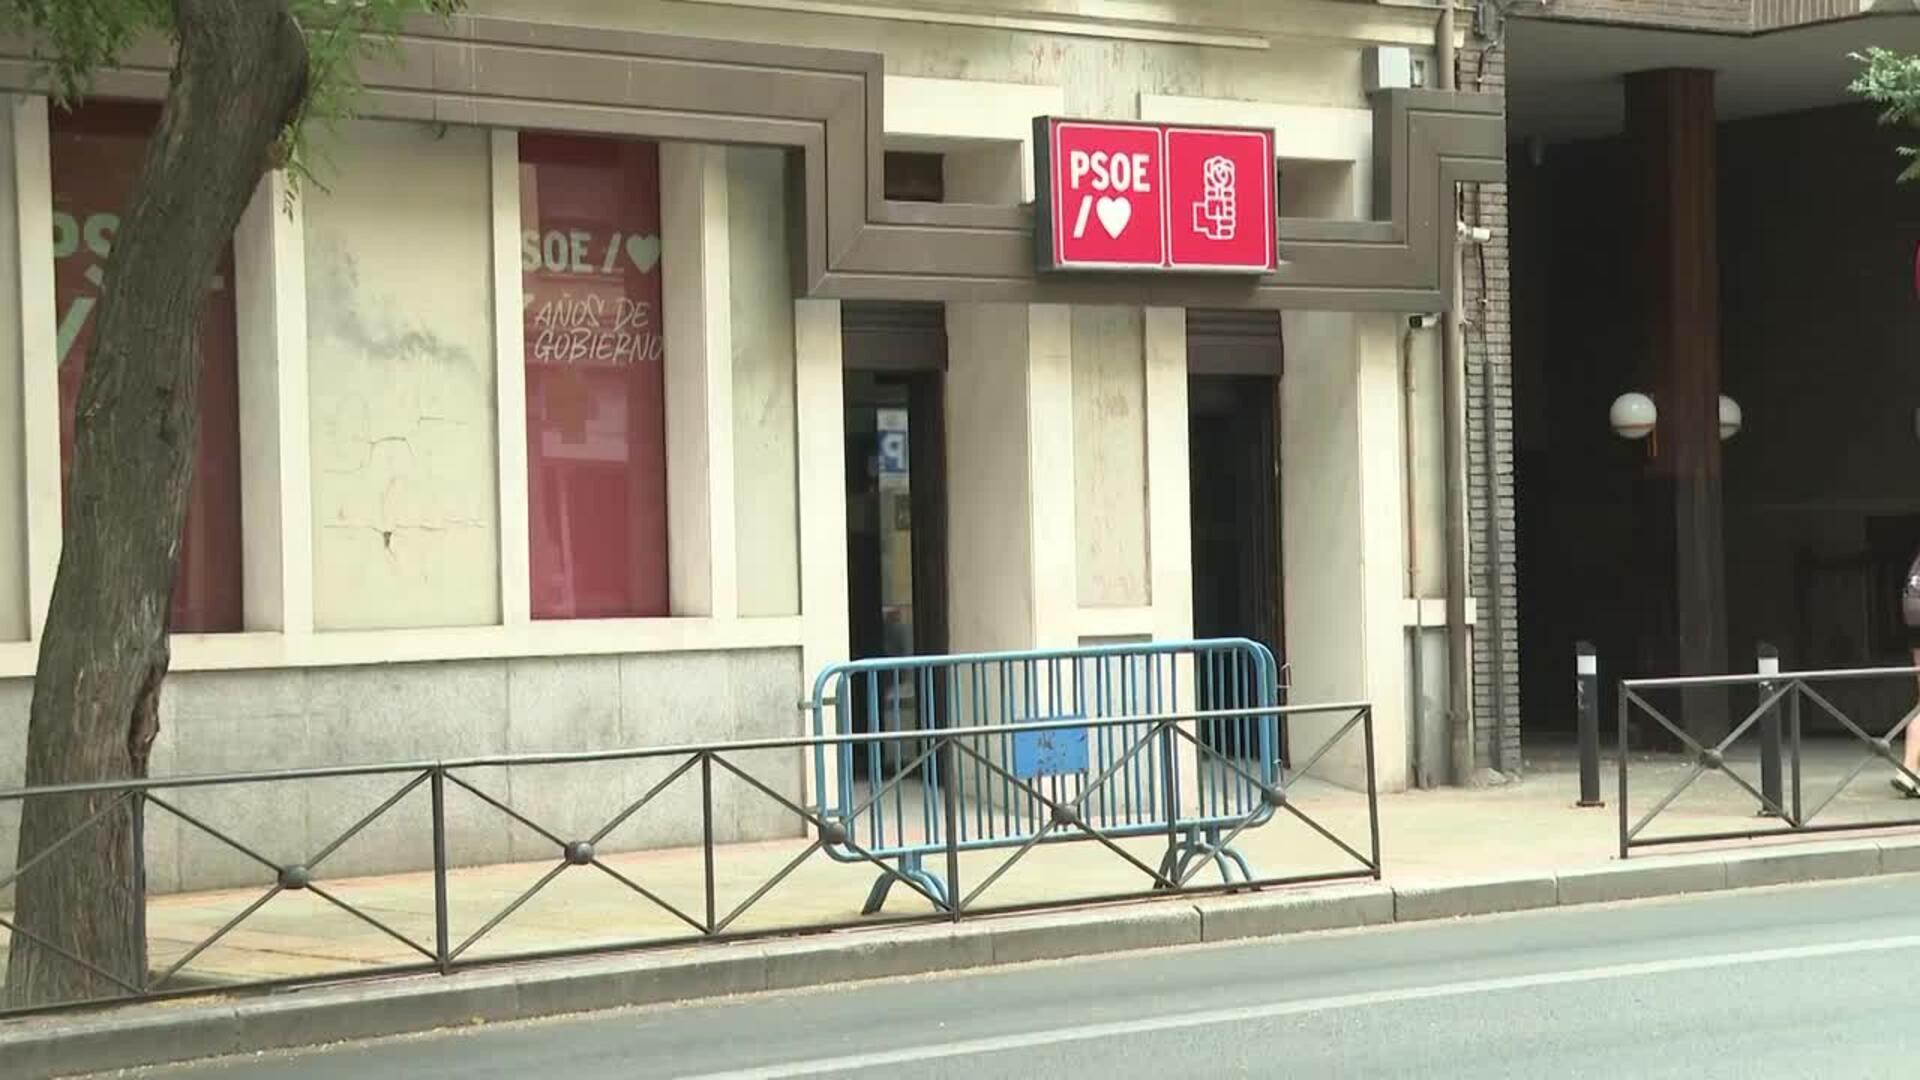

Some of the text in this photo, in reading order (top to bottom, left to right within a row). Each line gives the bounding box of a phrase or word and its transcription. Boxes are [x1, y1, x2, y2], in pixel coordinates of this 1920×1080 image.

[1070, 150, 1151, 193] PSOE
[522, 230, 594, 272] SOE
[535, 292, 605, 331] AÑOS
[612, 297, 649, 331] DE
